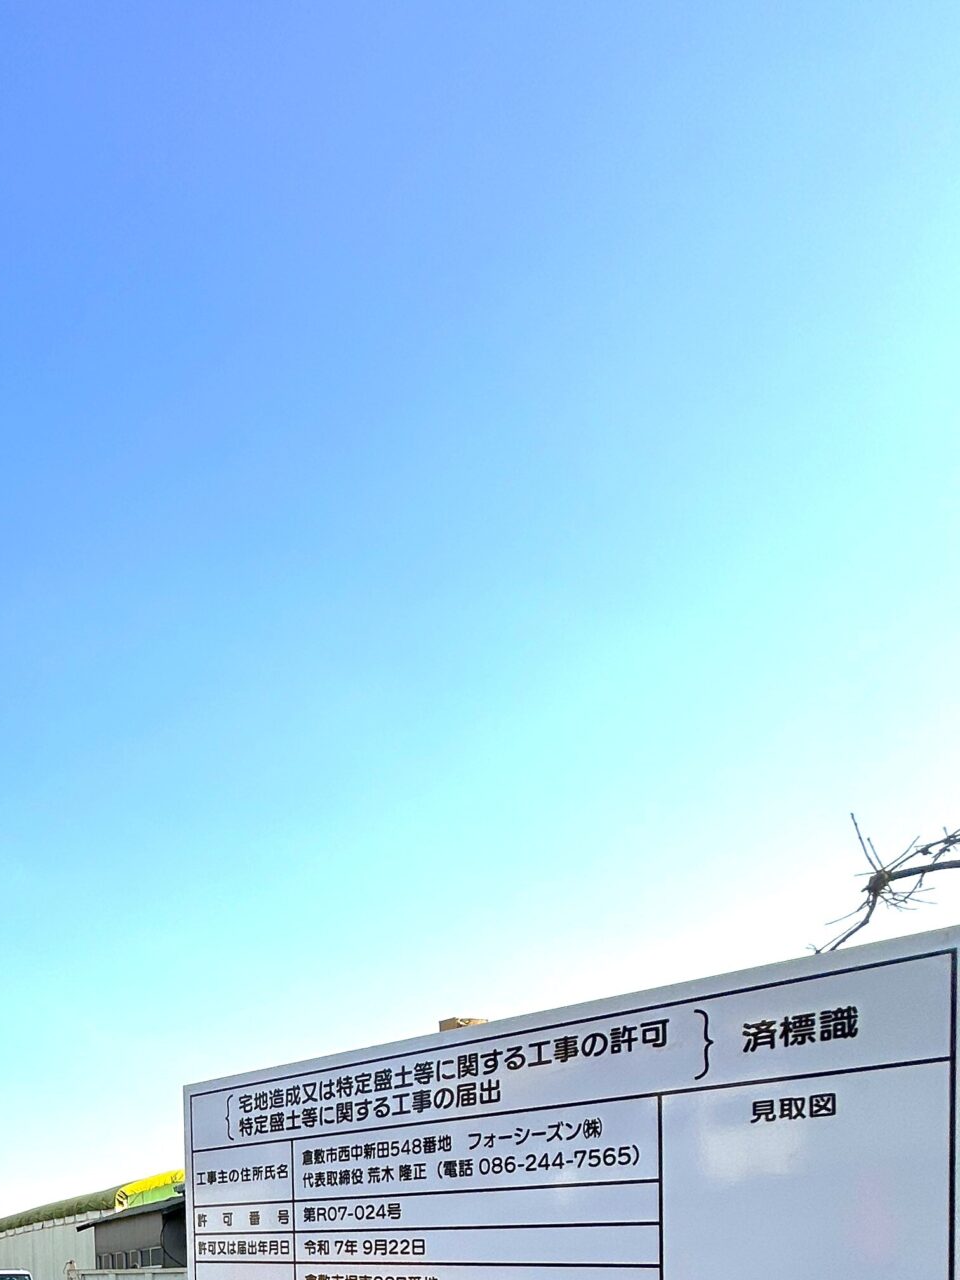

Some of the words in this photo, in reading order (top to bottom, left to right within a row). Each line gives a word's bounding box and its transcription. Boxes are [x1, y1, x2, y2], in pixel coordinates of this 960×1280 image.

[742, 1006, 858, 1053] 済標識
[239, 1019, 669, 1113] 宅地造成又は特定盛土等に関する工事の許可
[239, 1079, 502, 1137] 特定盛土等に関する工事の届出
[750, 1093, 836, 1123] 見取図
[302, 1135, 452, 1166] 倉敷市西中新田548番地
[196, 1164, 288, 1185] 工事主の住所氏名
[302, 1168, 364, 1188] 代表取締役
[367, 1165, 394, 1184] 荒木
[399, 1163, 427, 1181] 隆正
[303, 1203, 401, 1223] 第R07-024号
[198, 1240, 290, 1255] 許可又は届出年月日
